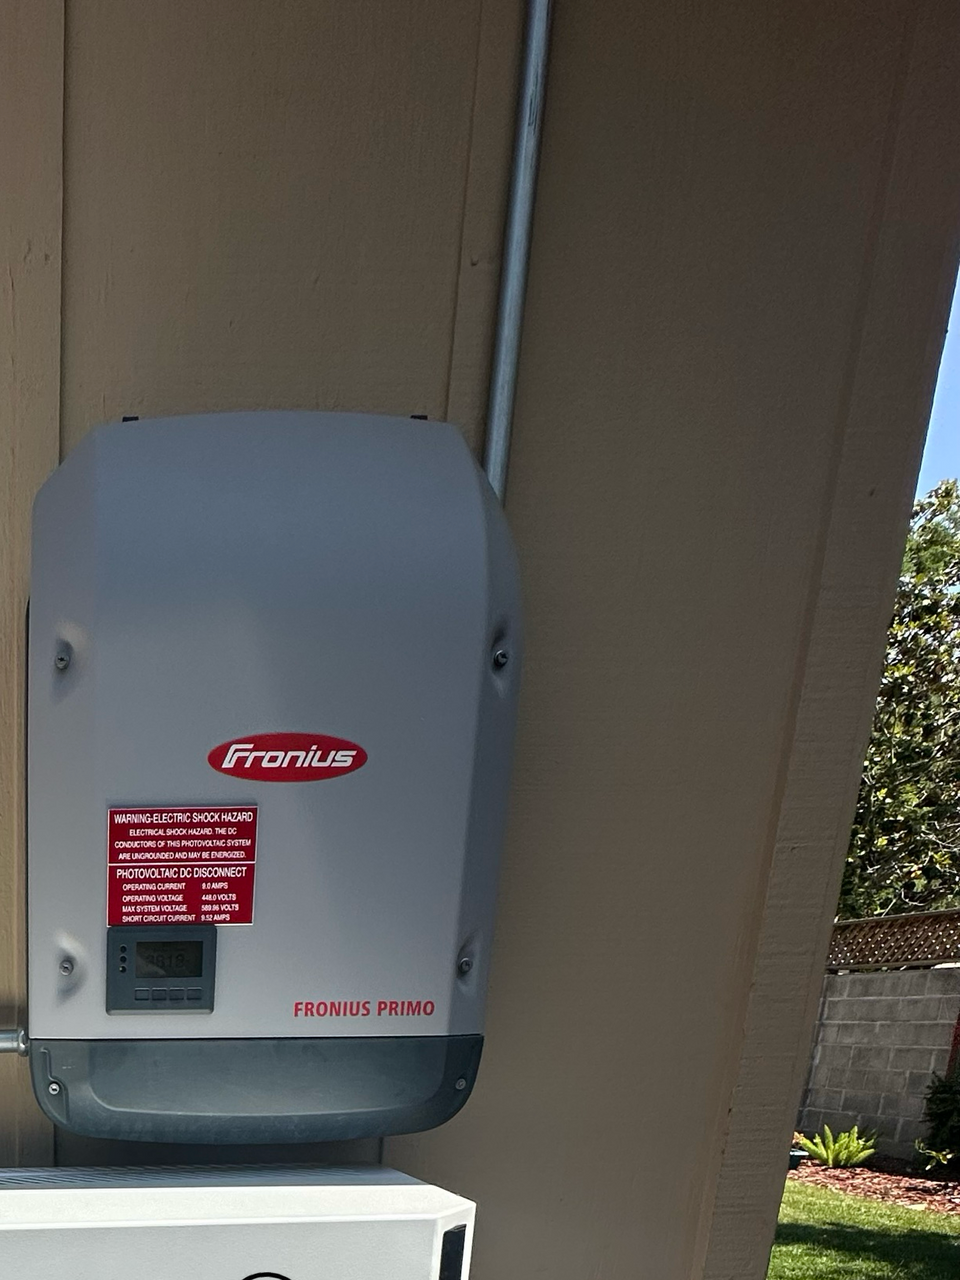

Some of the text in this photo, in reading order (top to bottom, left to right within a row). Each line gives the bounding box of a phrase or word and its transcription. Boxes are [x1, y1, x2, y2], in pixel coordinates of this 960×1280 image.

[222, 744, 357, 768] Fronius
[114, 812, 253, 824] WARNING-ELECTRIC SHOCK HAZARD
[129, 828, 165, 836] ELECTRICAL
[166, 828, 187, 836] SHOCK
[215, 827, 226, 835] THE
[228, 827, 237, 835] DC
[115, 840, 156, 848] CONDUCTORS
[157, 840, 166, 848] OF
[181, 839, 226, 847] PHOTOVOLTAIC
[118, 852, 131, 860] ARE
[132, 852, 174, 860] UNGROUNDED
[117, 867, 247, 879] PHOTOVOLTAIC DC DISCONNECT
[122, 883, 156, 891] OPERATING
[157, 894, 184, 902] VOLTAGE
[294, 1000, 435, 1017] FRONIUS PRIMO
